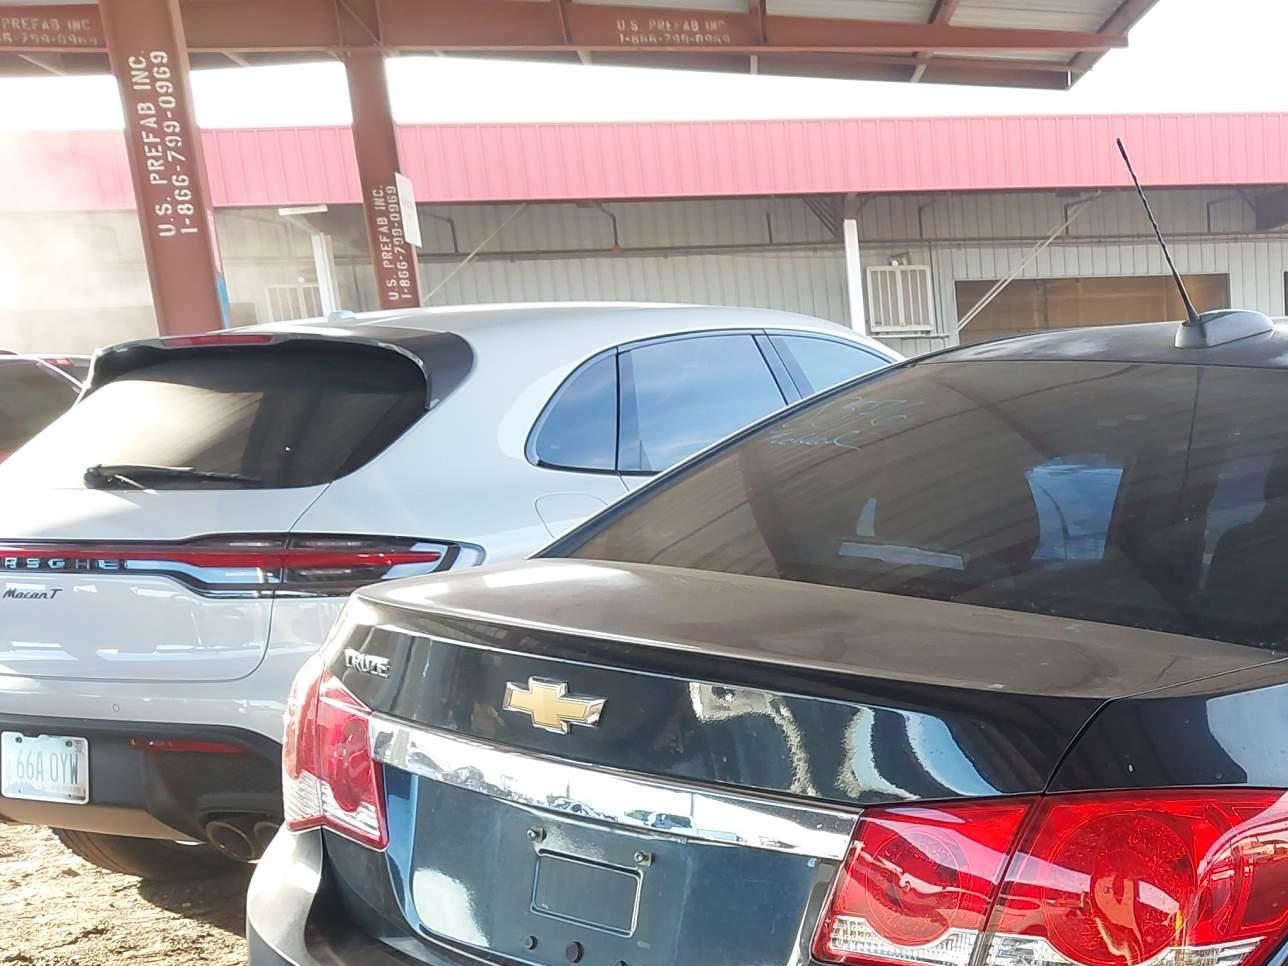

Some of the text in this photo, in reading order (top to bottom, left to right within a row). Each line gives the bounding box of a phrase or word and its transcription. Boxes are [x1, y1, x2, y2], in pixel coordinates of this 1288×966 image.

[137, 102, 168, 184] PREFAB
[150, 51, 198, 233] 1-866-799-0969
[155, 196, 176, 236] U.S.
[376, 216, 395, 268] PREFAB
[385, 185, 412, 299] 1-866-799-0969
[386, 274, 399, 300] U.S.
[3, 588, 63, 600] Macan T
